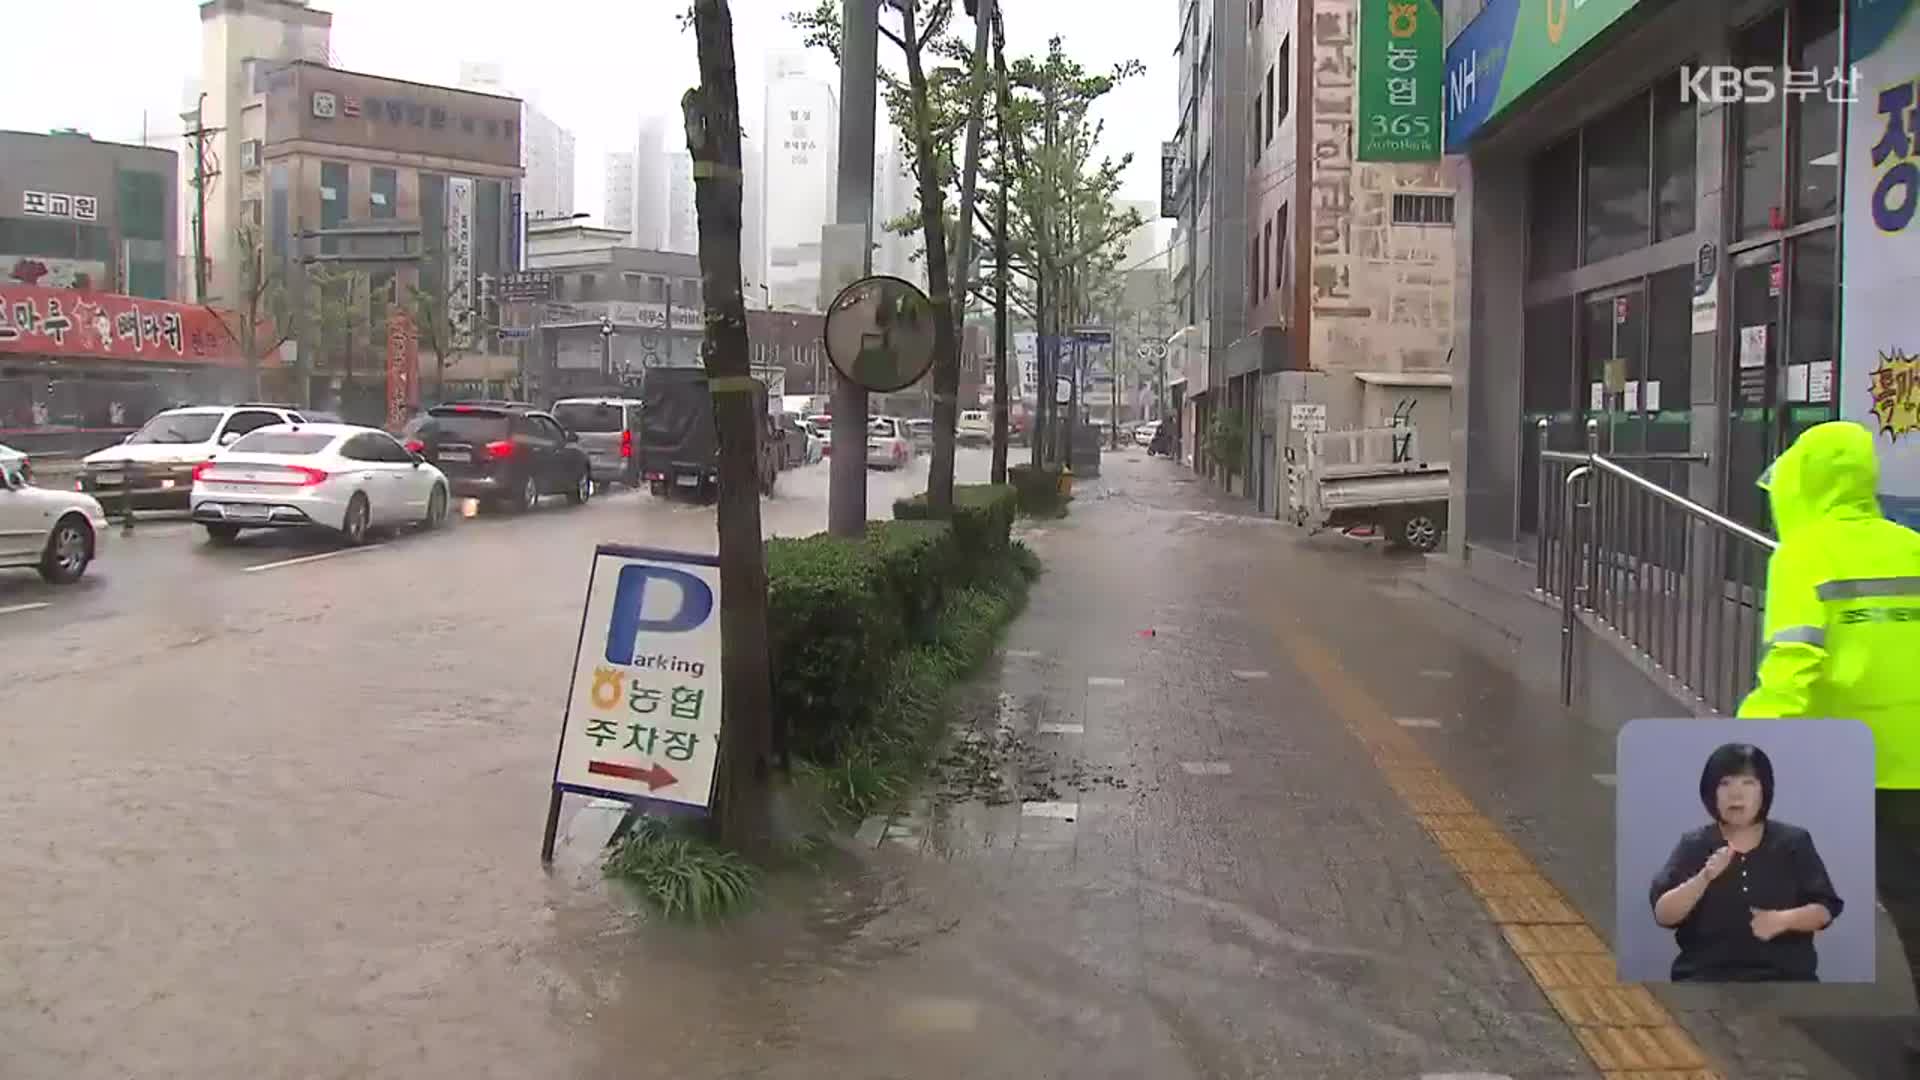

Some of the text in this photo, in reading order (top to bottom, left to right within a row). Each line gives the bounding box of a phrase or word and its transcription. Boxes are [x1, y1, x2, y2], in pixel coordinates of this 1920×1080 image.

[1387, 40, 1418, 106] 농협
[1450, 49, 1477, 121] NH
[1370, 114, 1431, 138] 365
[24, 191, 95, 219] 포교원
[116, 303, 184, 354] 뼈다귀
[628, 679, 706, 721] 농협
[584, 718, 700, 762] 주차장
